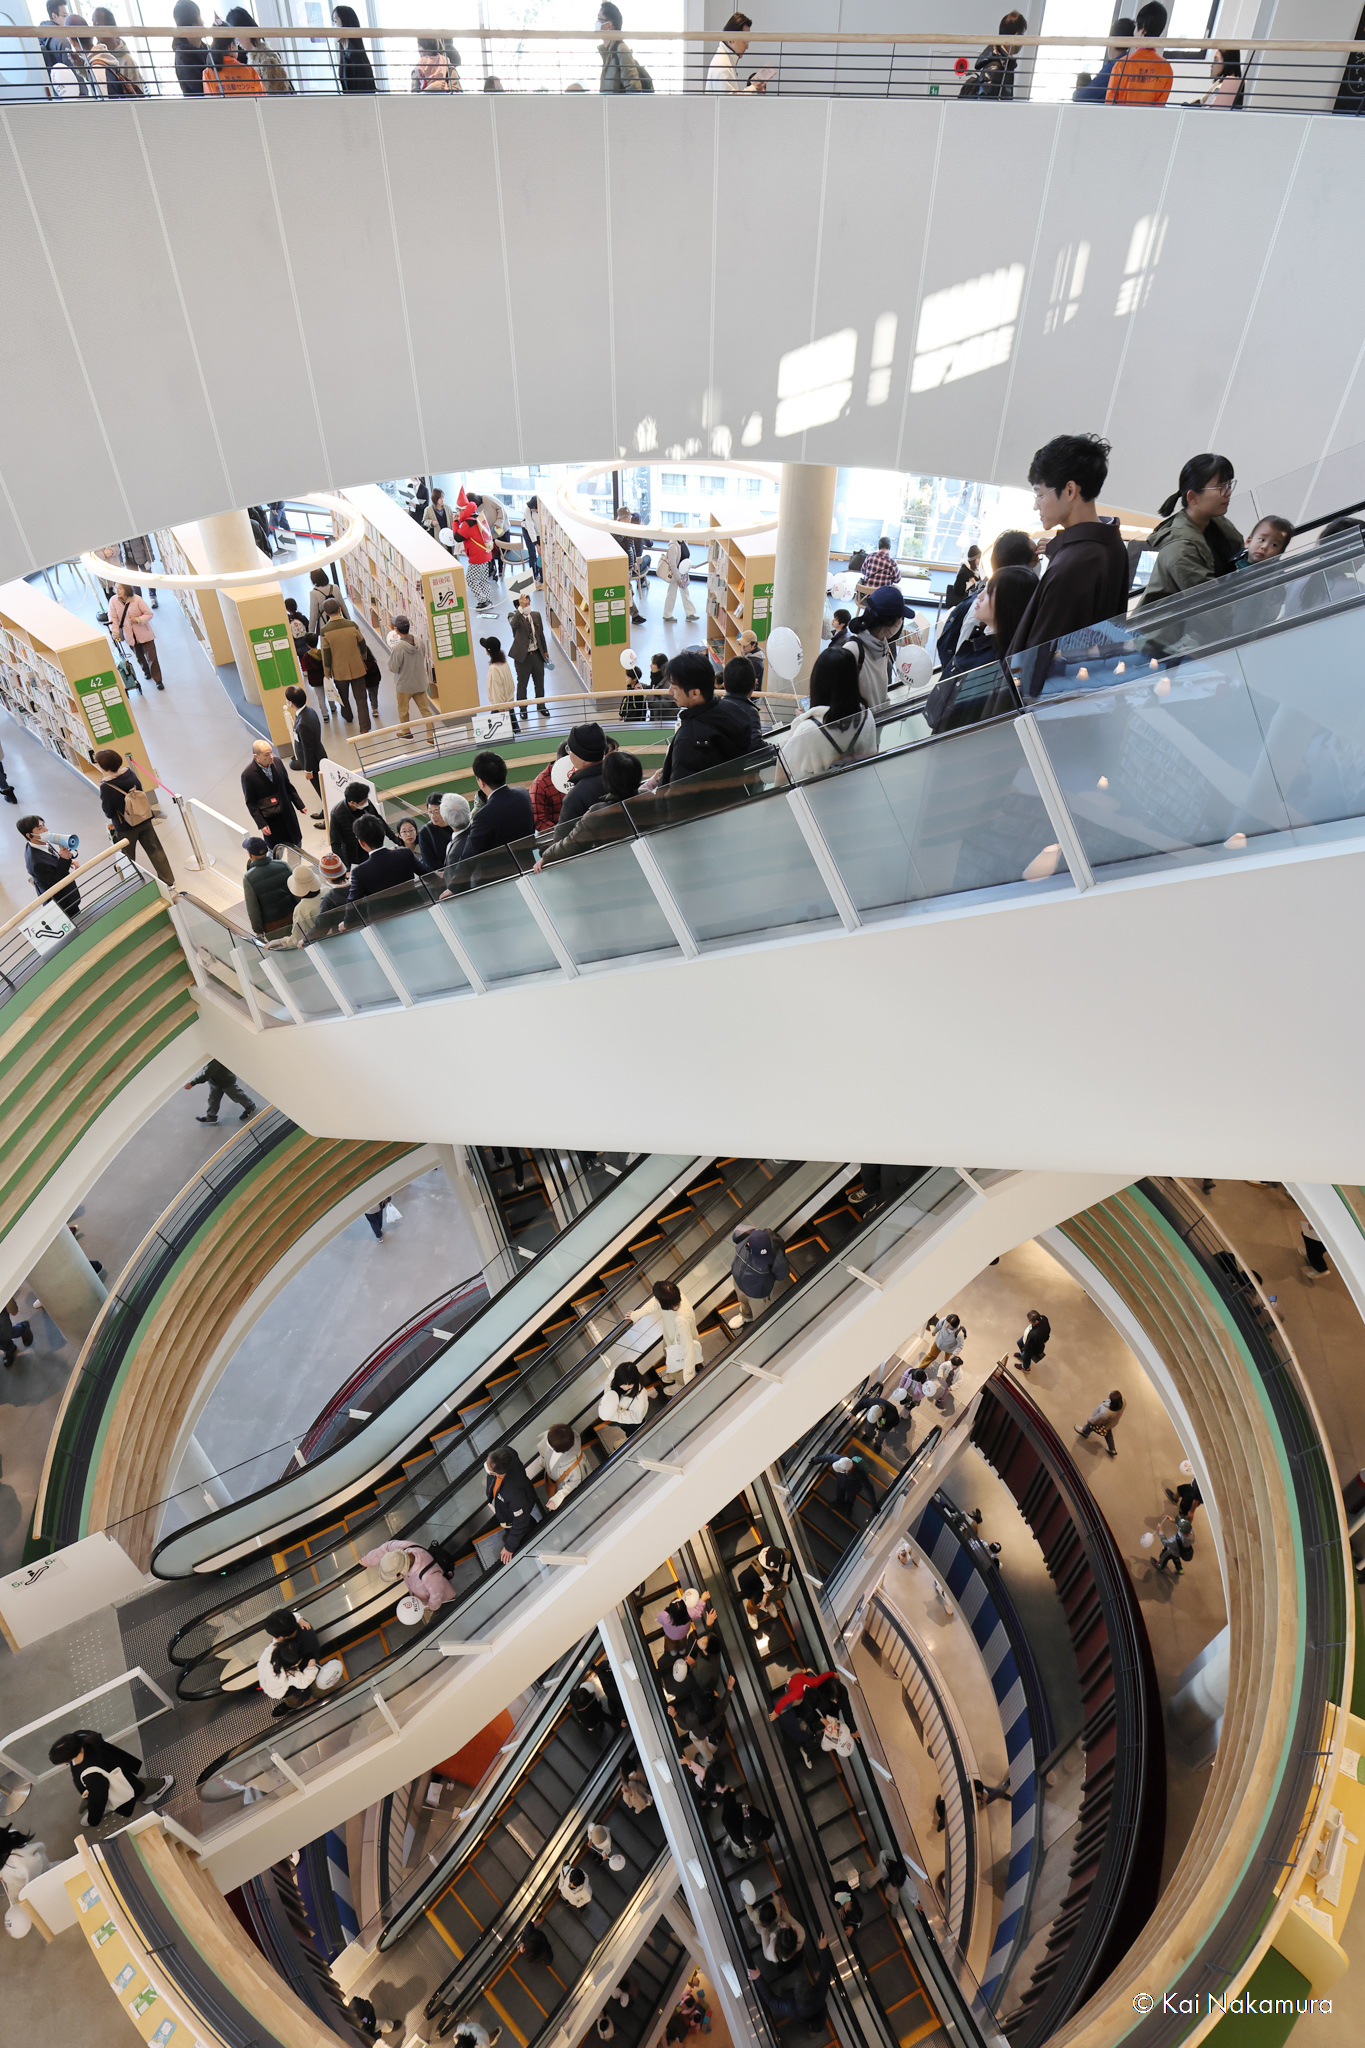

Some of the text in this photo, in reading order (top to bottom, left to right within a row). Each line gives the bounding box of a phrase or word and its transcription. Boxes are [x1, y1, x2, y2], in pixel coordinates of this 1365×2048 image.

[604, 589, 615, 598] 45
[263, 628, 275, 638] 43
[90, 676, 103, 688] 42
